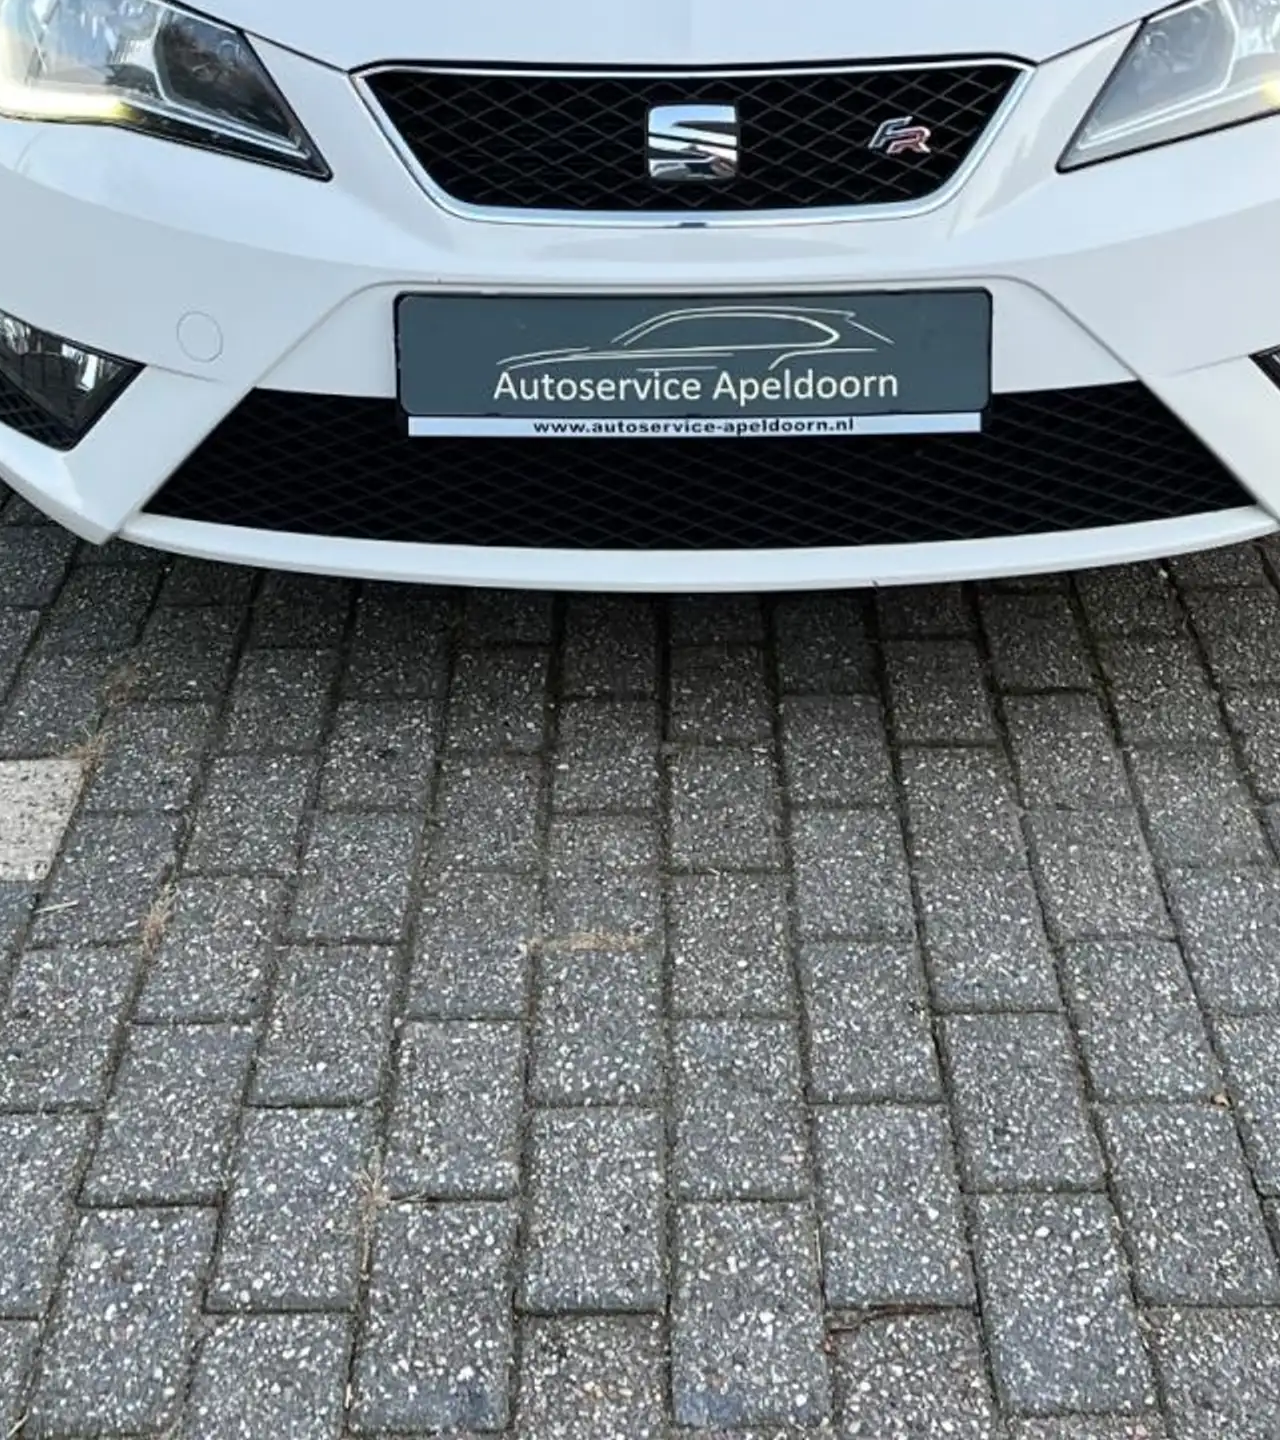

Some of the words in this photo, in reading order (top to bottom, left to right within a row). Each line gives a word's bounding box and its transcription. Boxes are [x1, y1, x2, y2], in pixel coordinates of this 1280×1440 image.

[868, 116, 931, 155] FR
[493, 371, 701, 402] Autoservice
[713, 368, 898, 406] Apeldoorn
[533, 418, 855, 437] www.autoservice-apeldoorn.nl
